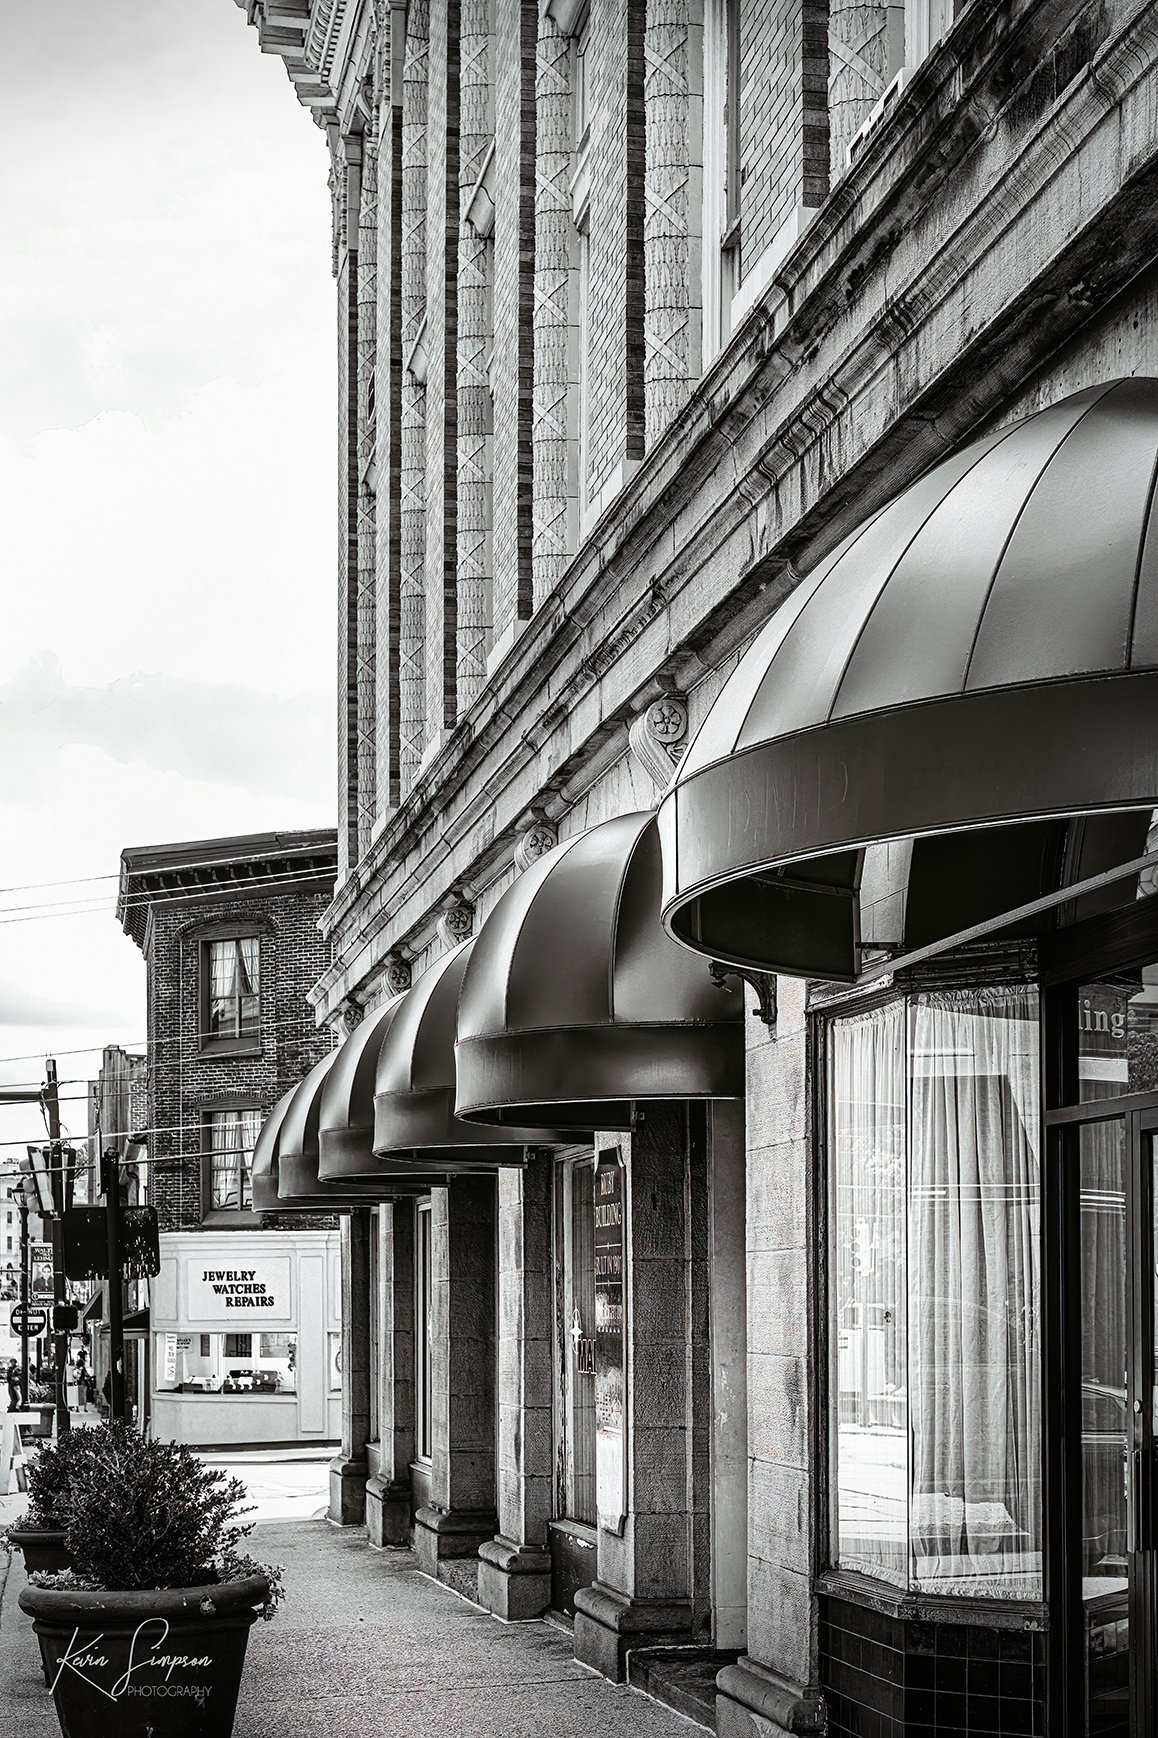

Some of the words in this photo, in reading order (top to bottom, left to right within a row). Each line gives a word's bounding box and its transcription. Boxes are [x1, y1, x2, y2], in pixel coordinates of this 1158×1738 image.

[202, 1270, 256, 1282] JEWELRY
[212, 1283, 266, 1295] WATCHES
[225, 1296, 275, 1307] REPAIRS
[17, 1324, 39, 1332] ETER
